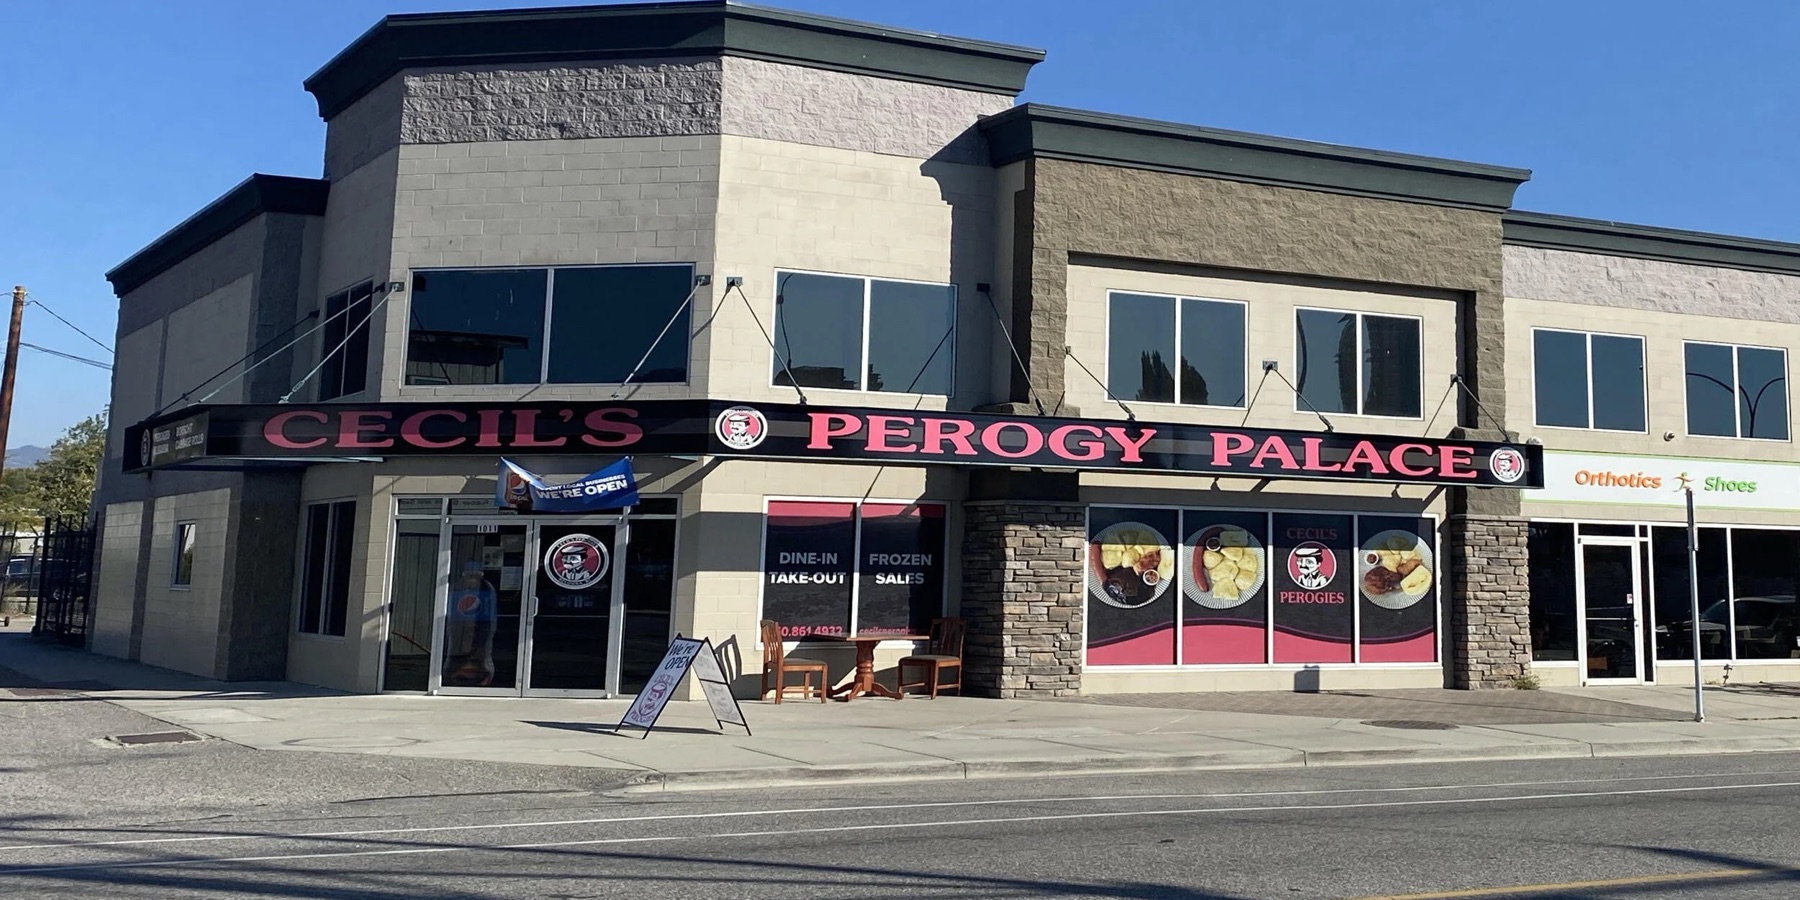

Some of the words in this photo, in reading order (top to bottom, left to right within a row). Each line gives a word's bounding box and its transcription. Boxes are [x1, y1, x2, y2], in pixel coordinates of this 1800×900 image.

[262, 408, 644, 449] CECIL'S
[806, 412, 1158, 463] PEROGY
[1210, 432, 1478, 479] PALACE
[585, 474, 626, 486] BUSINESSES
[1574, 469, 1662, 489] Orthotics
[1703, 476, 1758, 493] Shoes
[536, 488, 584, 499] WE'RE
[584, 480, 628, 496] OPEN
[477, 525, 498, 533] 1011
[1286, 527, 1338, 541] CECIL'S
[779, 552, 838, 565] DINE-IN
[869, 553, 932, 566] FROZEN
[769, 571, 847, 584] TAKE-OUT
[875, 572, 924, 585] SALES
[1280, 591, 1345, 604] PEROGIES
[669, 643, 695, 657] We're
[664, 656, 691, 671] OPEN
